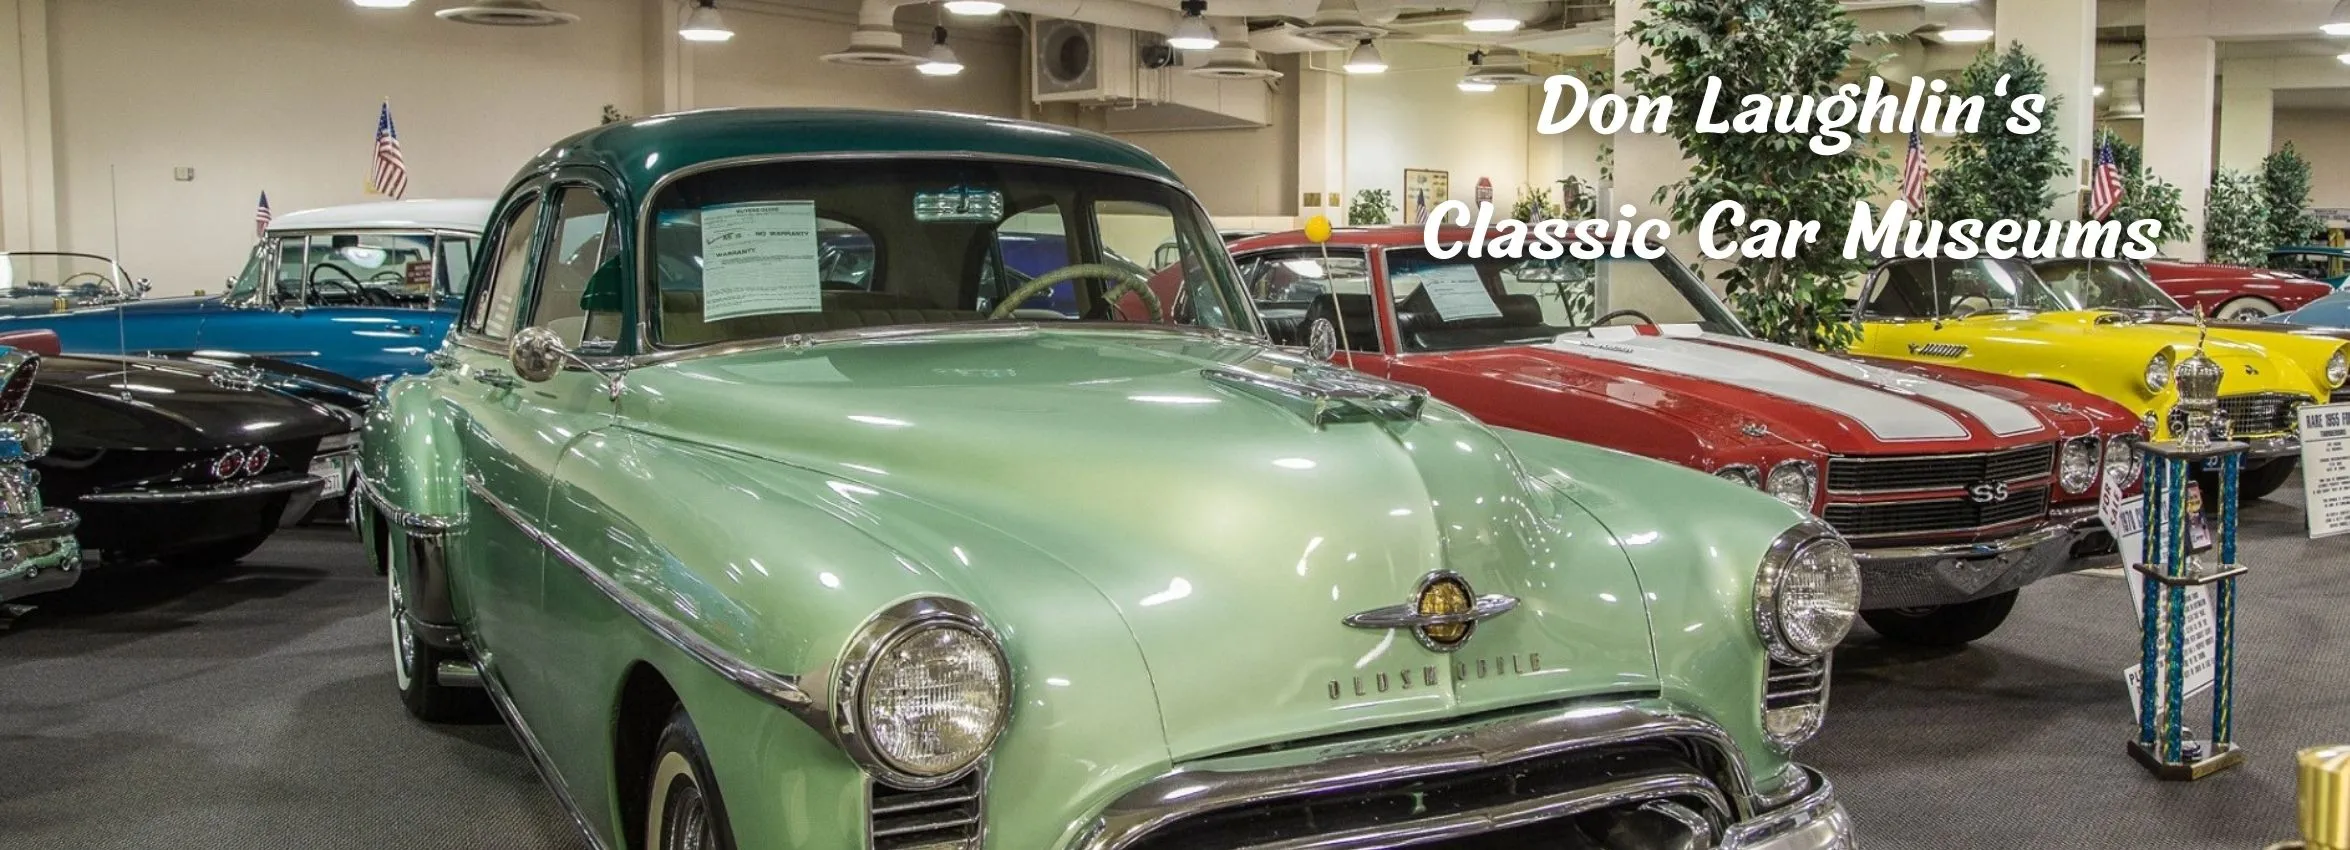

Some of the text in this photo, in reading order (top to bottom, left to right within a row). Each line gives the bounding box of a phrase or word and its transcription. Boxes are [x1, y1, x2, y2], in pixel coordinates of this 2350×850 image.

[716, 247, 756, 257] WARRANTY
[2306, 414, 2323, 428] RARE
[1972, 482, 2009, 503] SS
[2102, 482, 2111, 515] FOR
[2110, 489, 2119, 528] SALE
[1328, 653, 1542, 700] OLDSMOBILE
